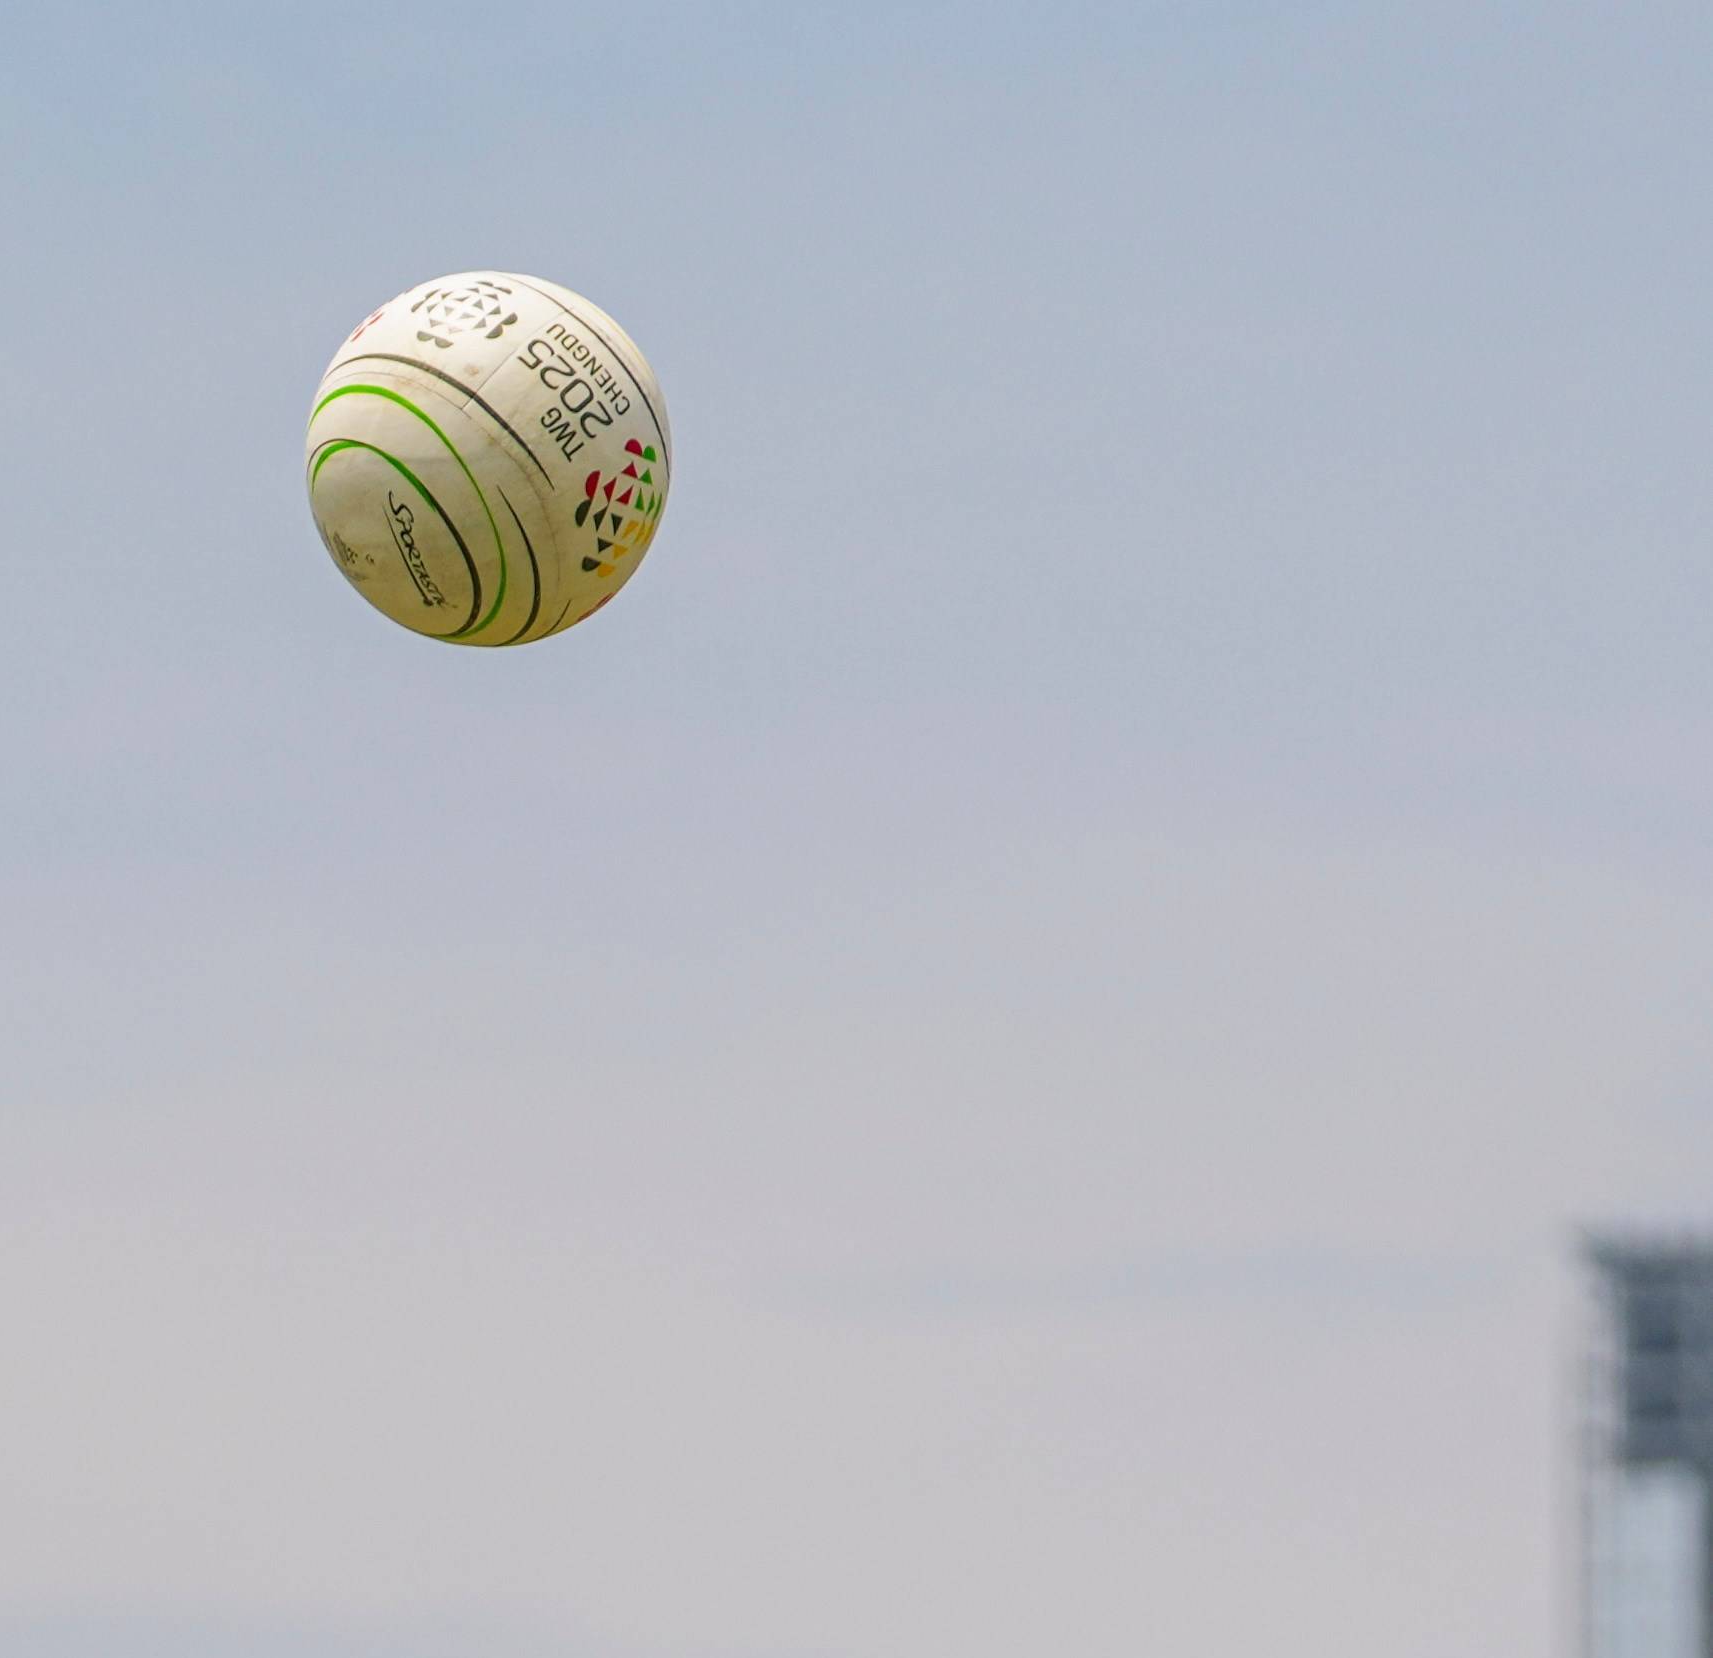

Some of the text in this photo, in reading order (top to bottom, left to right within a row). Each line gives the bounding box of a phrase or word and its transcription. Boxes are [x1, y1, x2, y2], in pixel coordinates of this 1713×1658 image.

[517, 338, 614, 439] 2025
[546, 323, 631, 416] CHENGDU
[540, 407, 585, 463] TWG
